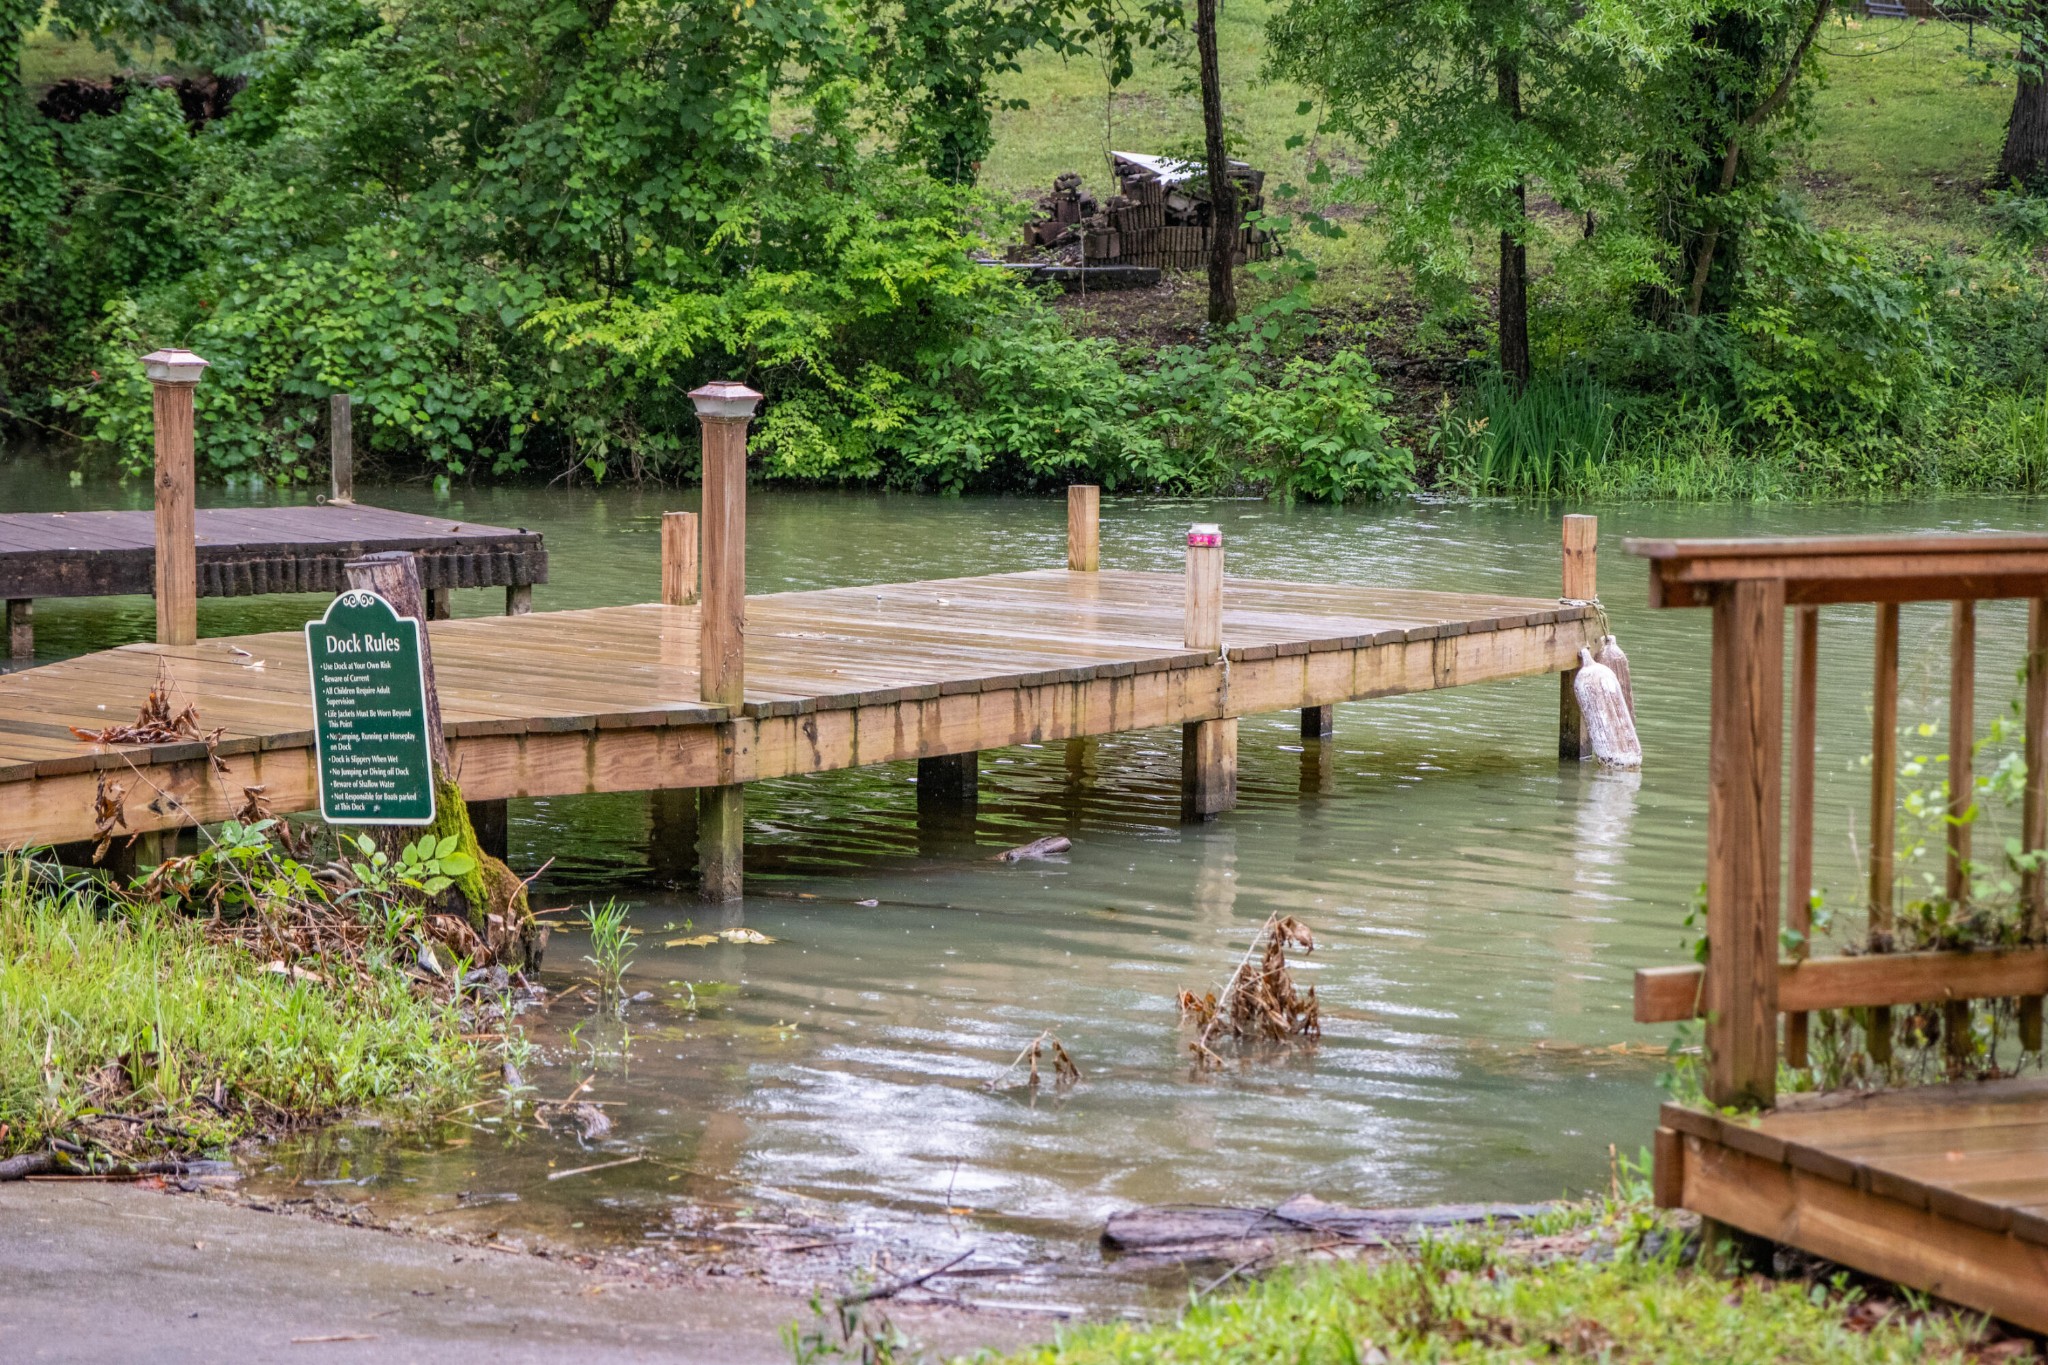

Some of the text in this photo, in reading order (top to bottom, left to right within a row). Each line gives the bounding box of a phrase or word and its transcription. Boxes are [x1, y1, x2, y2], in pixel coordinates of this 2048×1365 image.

[326, 632, 400, 653] Dock Rules
[334, 662, 347, 670] Dock
[366, 661, 379, 669] Own
[380, 661, 391, 669] Risk
[344, 674, 349, 682] of
[333, 686, 355, 695] Children
[356, 686, 375, 696] Require
[376, 686, 390, 694] Adult
[326, 698, 355, 707] Supervision
[327, 710, 337, 718] Life
[338, 710, 355, 718] Jackets
[377, 709, 392, 717] Worn
[392, 709, 411, 718] Beyond
[328, 720, 352, 728] This Point
[361, 732, 382, 742] Running
[389, 732, 415, 742] Horseplay
[331, 755, 345, 763] Dock
[351, 755, 371, 764] Slippery
[332, 768, 340, 776] No
[341, 768, 362, 777] Jumping
[369, 767, 386, 777] Diving
[387, 767, 395, 775] off
[395, 767, 409, 776] Dock
[352, 780, 358, 788] of
[359, 780, 378, 788] Shallow
[379, 780, 395, 788] Water
[345, 792, 374, 802] Responsible
[375, 792, 383, 800] for
[399, 792, 417, 802] parked
[335, 803, 341, 811] at
[351, 803, 365, 811] Dock
